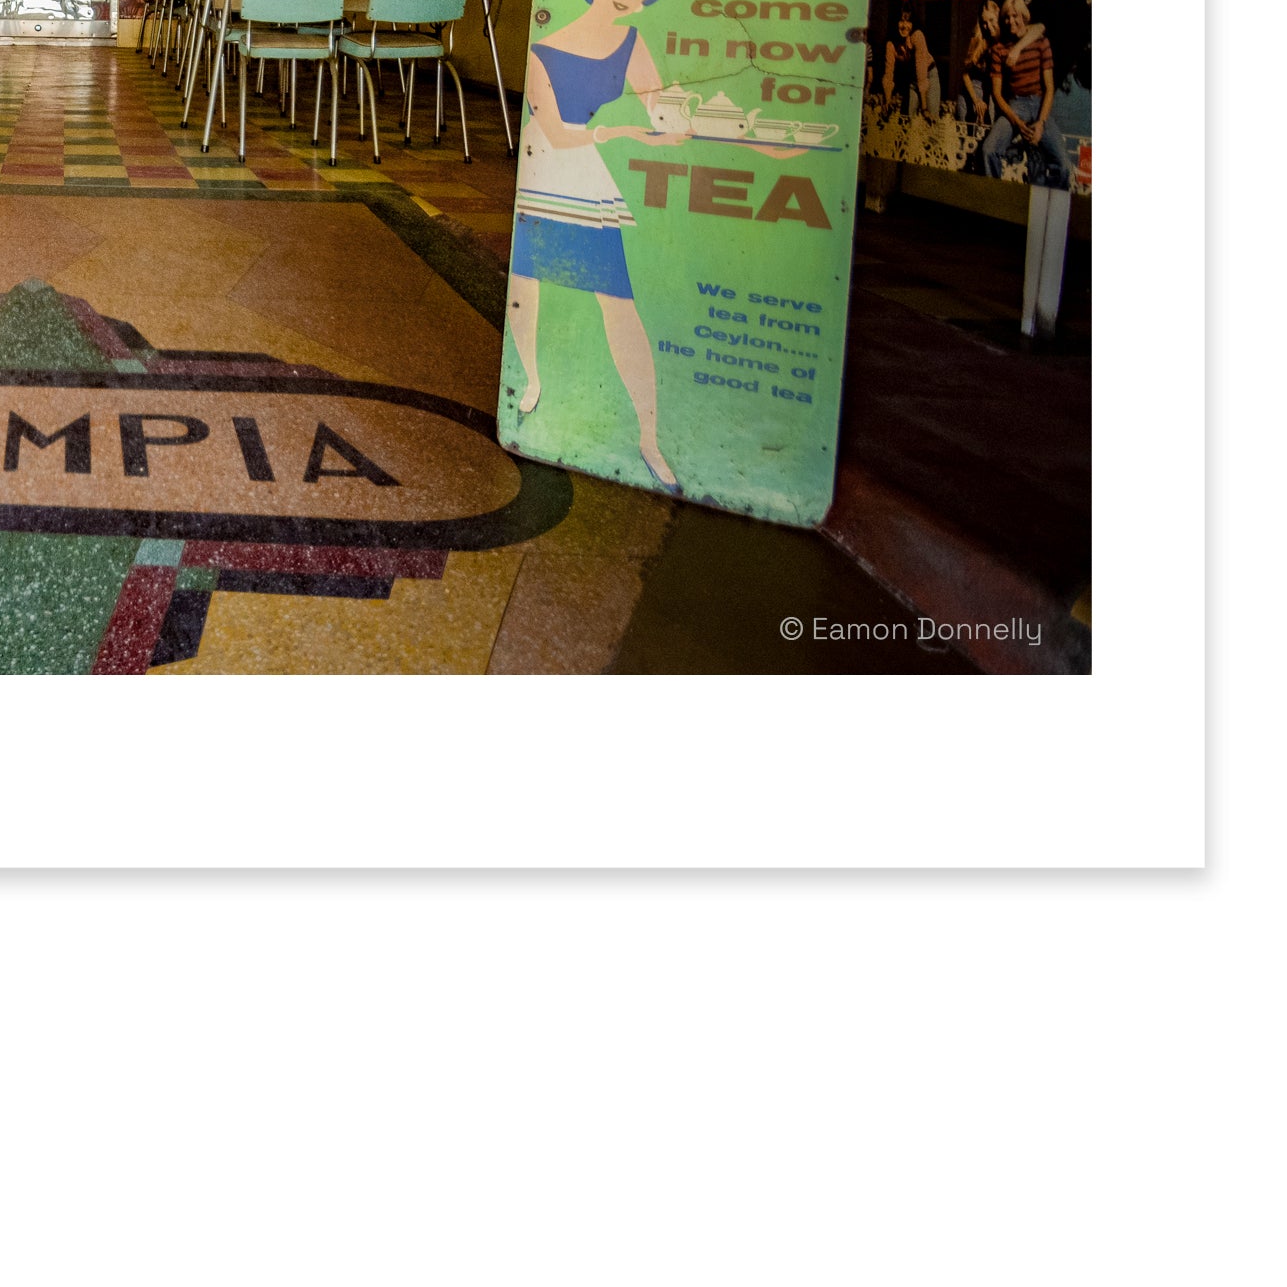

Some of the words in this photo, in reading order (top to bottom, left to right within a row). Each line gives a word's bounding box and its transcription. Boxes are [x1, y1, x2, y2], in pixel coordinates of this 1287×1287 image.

[665, 31, 710, 57] in
[725, 39, 848, 64] now
[760, 76, 837, 107] for
[628, 158, 833, 231] TEA
[696, 281, 737, 300] We
[747, 292, 823, 313] serve
[708, 307, 748, 325] tea
[759, 313, 821, 336] from
[658, 340, 696, 358] the
[705, 348, 780, 374] home
[790, 367, 817, 381] of
[693, 370, 759, 394] good
[771, 384, 813, 405] tea
